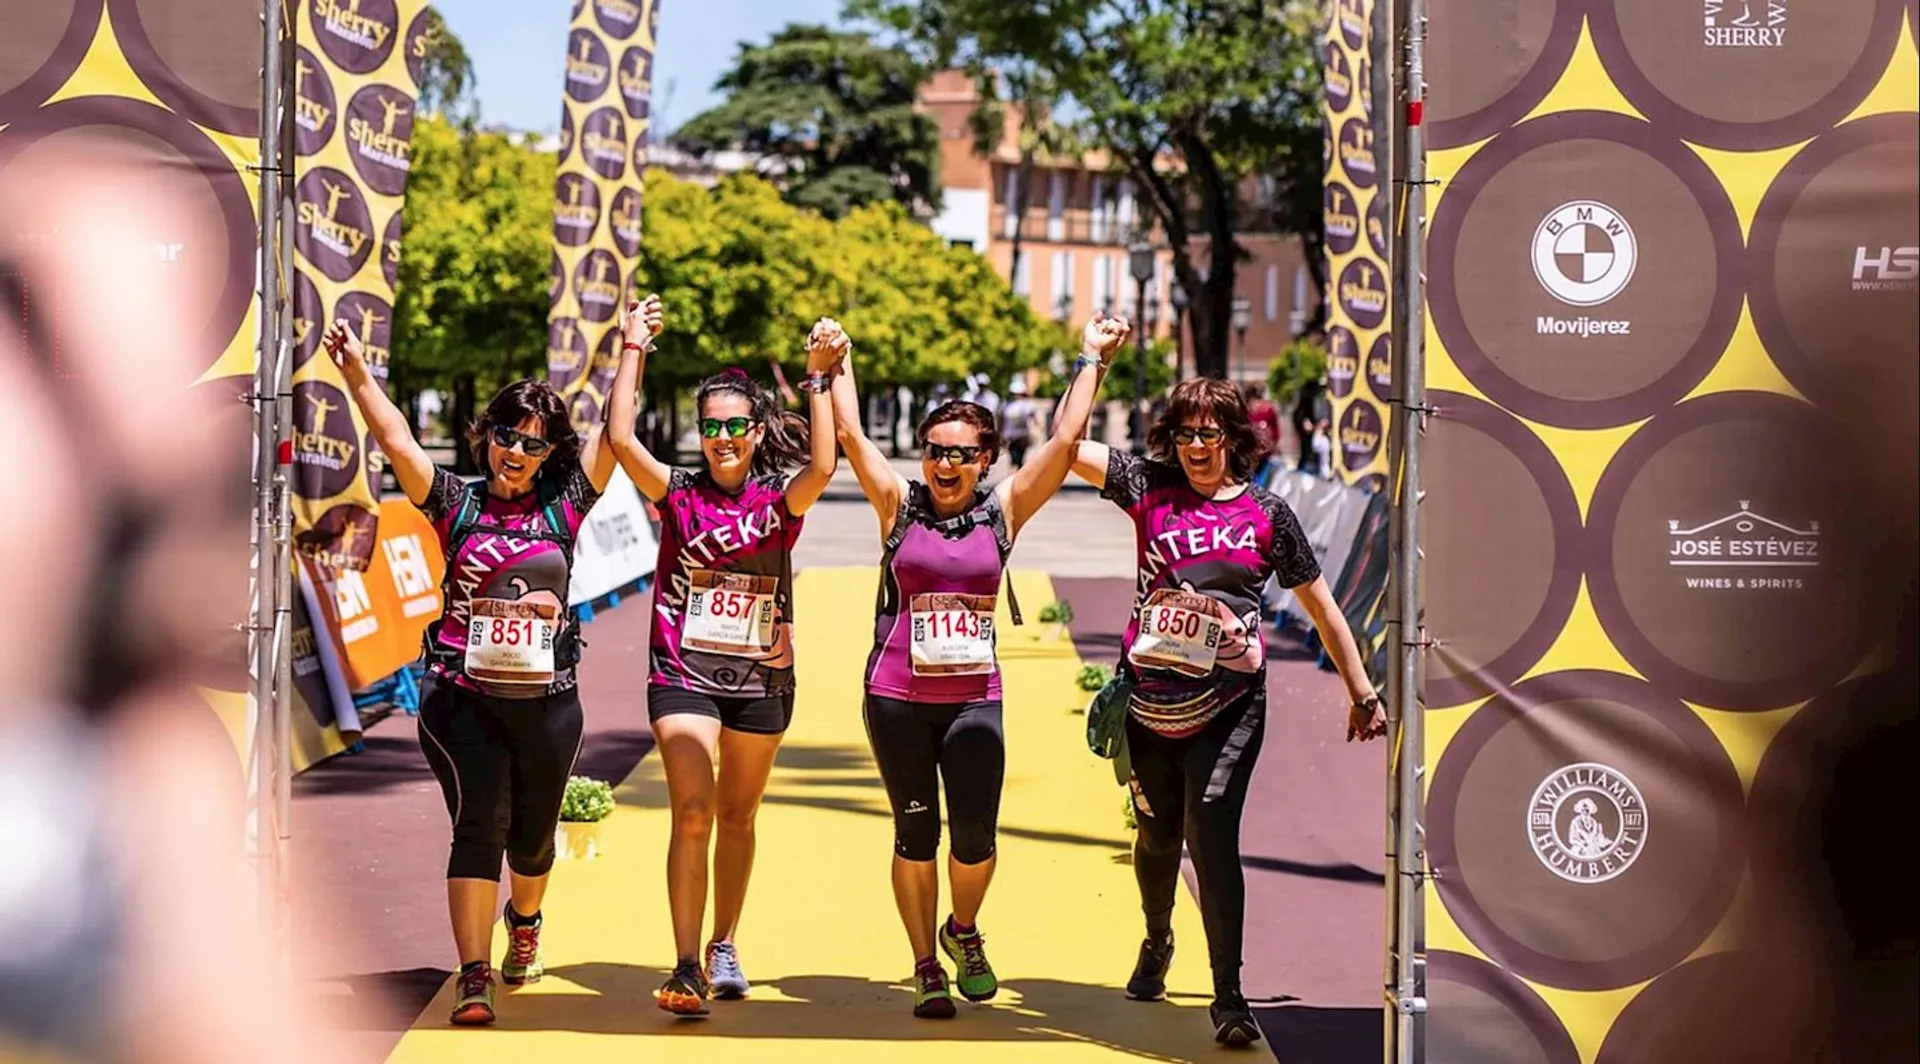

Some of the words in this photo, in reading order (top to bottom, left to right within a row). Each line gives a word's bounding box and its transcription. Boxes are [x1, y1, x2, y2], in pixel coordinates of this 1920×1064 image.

[1704, 27, 1786, 46] SHERRY
[349, 118, 411, 160] Sherr
[1546, 207, 1624, 237] BMW
[1537, 317, 1630, 338] Movijerez
[292, 425, 354, 468] herry
[1670, 536, 1722, 556] JOSÉ
[1730, 537, 1818, 556] ESTÉVEZ
[1686, 578, 1731, 588] WINES
[1737, 578, 1745, 588] &
[1750, 578, 1803, 589] SPIRITS
[711, 591, 757, 619] 857
[490, 618, 533, 646] 851
[927, 611, 979, 638] 1143
[1157, 607, 1200, 638] 850
[1539, 769, 1636, 807] WILLIAMS
[1537, 832, 1637, 878] HUMBERT
